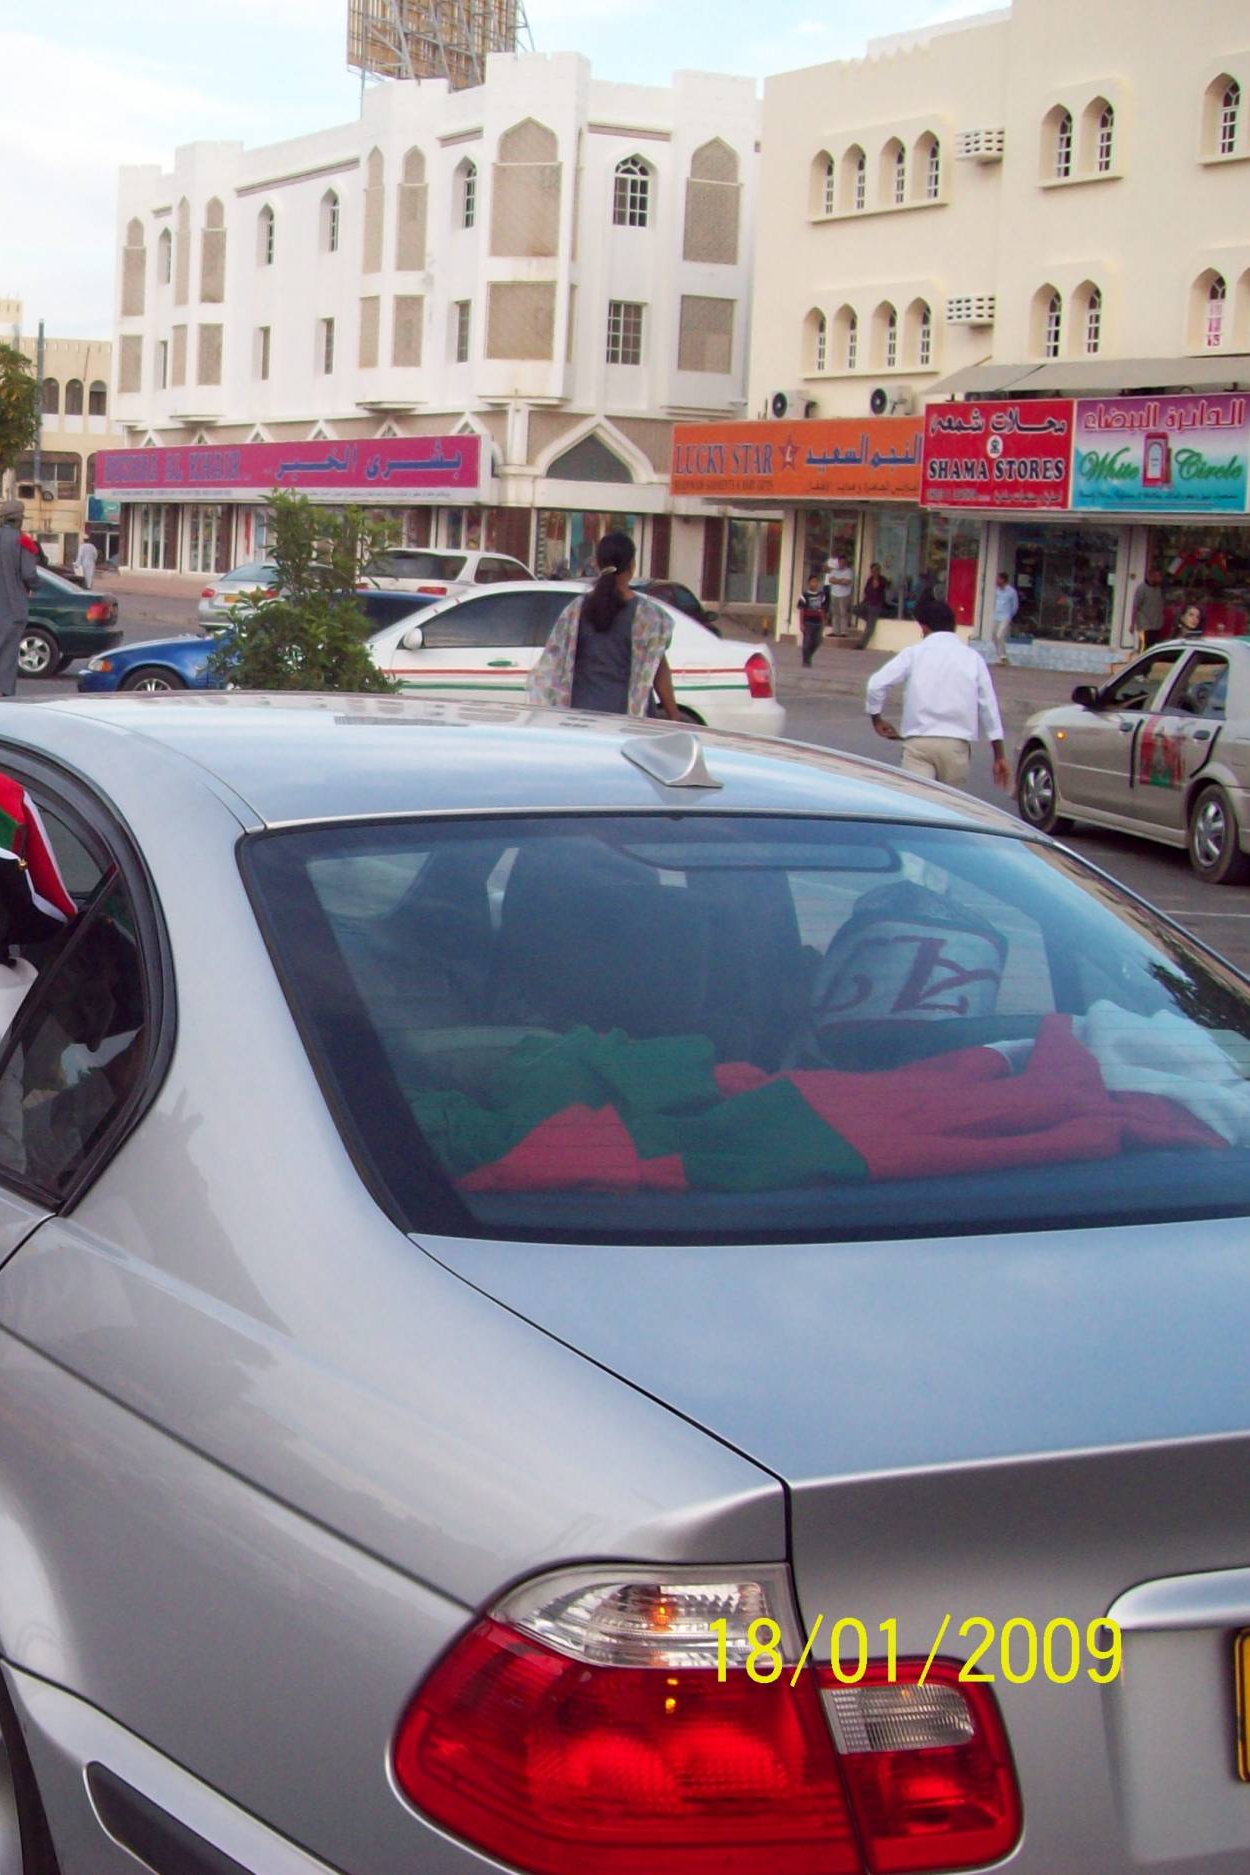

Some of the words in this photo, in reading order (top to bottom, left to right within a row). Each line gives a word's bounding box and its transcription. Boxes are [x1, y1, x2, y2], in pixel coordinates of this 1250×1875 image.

[990, 406, 1066, 434] محلات
[275, 443, 358, 481] الخير
[366, 438, 462, 480] بشرى
[675, 443, 726, 476] LUCKY
[730, 443, 773, 476] STAR
[805, 432, 870, 472] السعيد
[928, 458, 989, 480] SHAMA
[993, 457, 1066, 480] STORES
[1079, 447, 1140, 481] White
[1174, 448, 1243, 481] Circle
